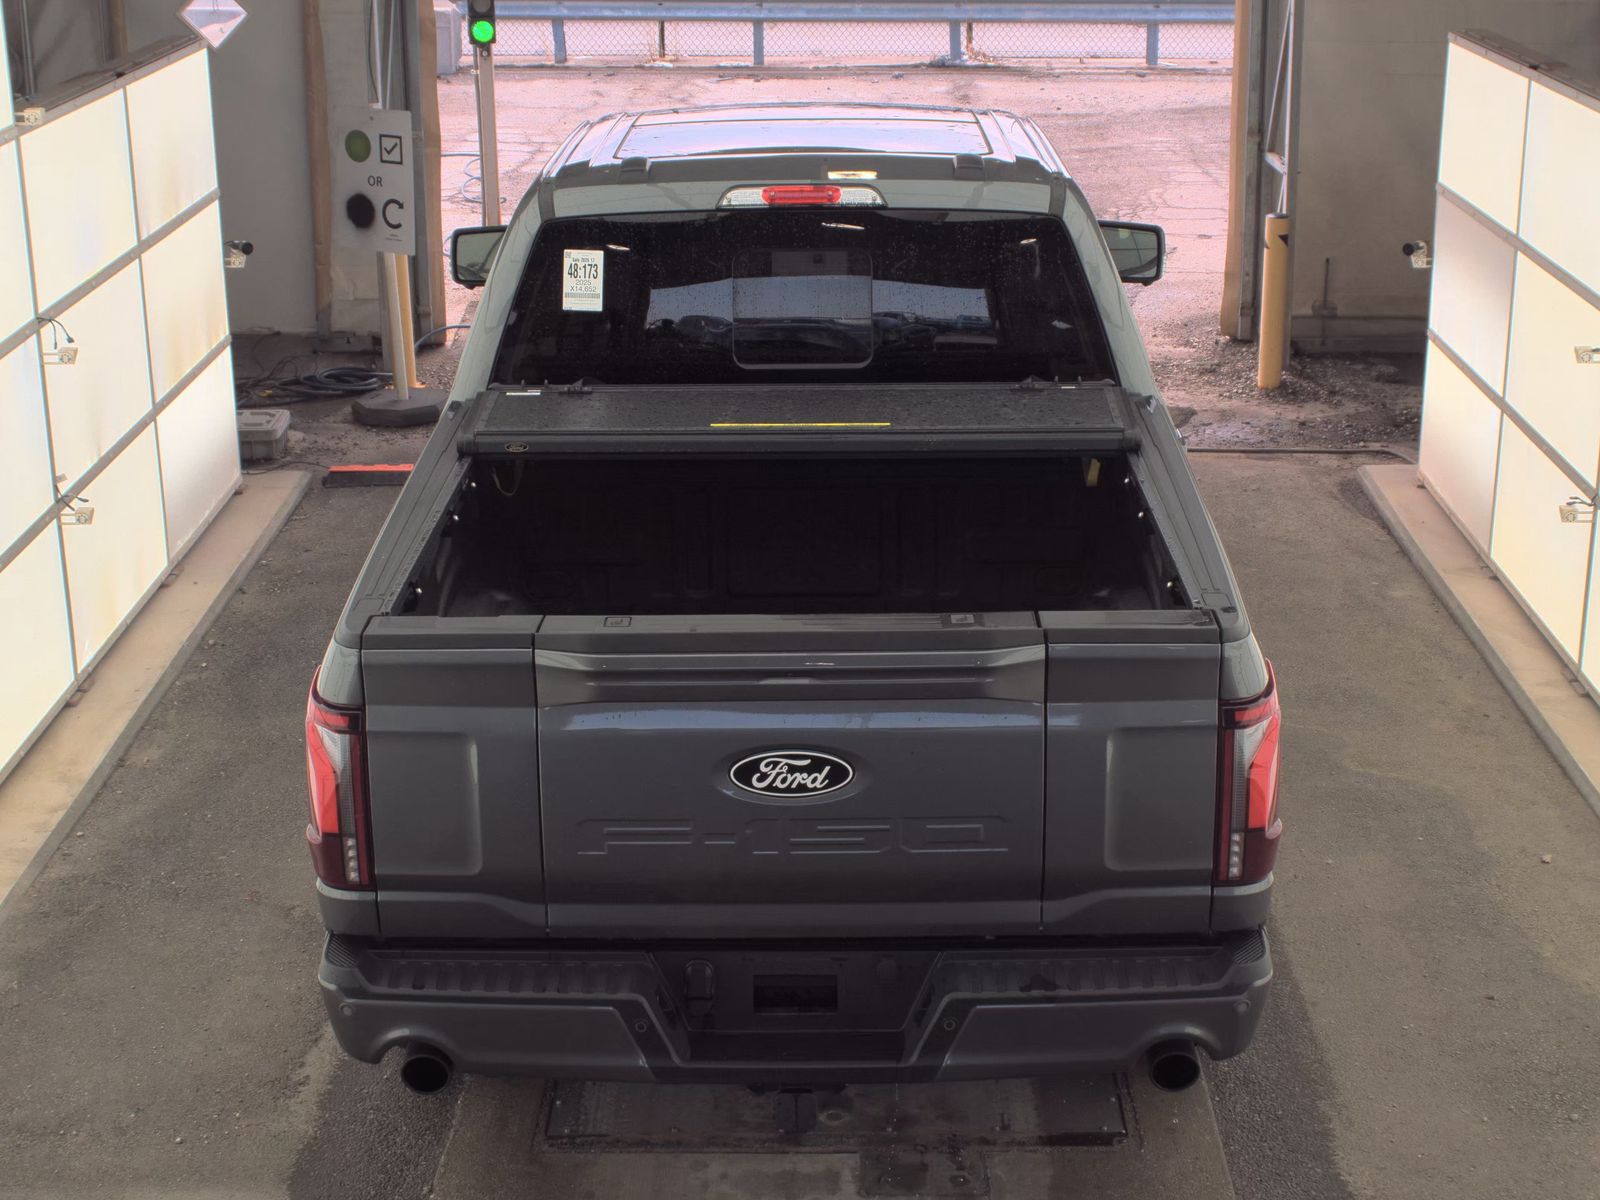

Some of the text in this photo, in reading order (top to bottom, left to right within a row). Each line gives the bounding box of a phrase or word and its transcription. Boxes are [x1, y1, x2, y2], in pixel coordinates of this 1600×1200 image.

[367, 175, 383, 188] OR
[568, 262, 598, 279] 48:173
[751, 757, 831, 790] Ford
[576, 816, 1009, 855] F-150
